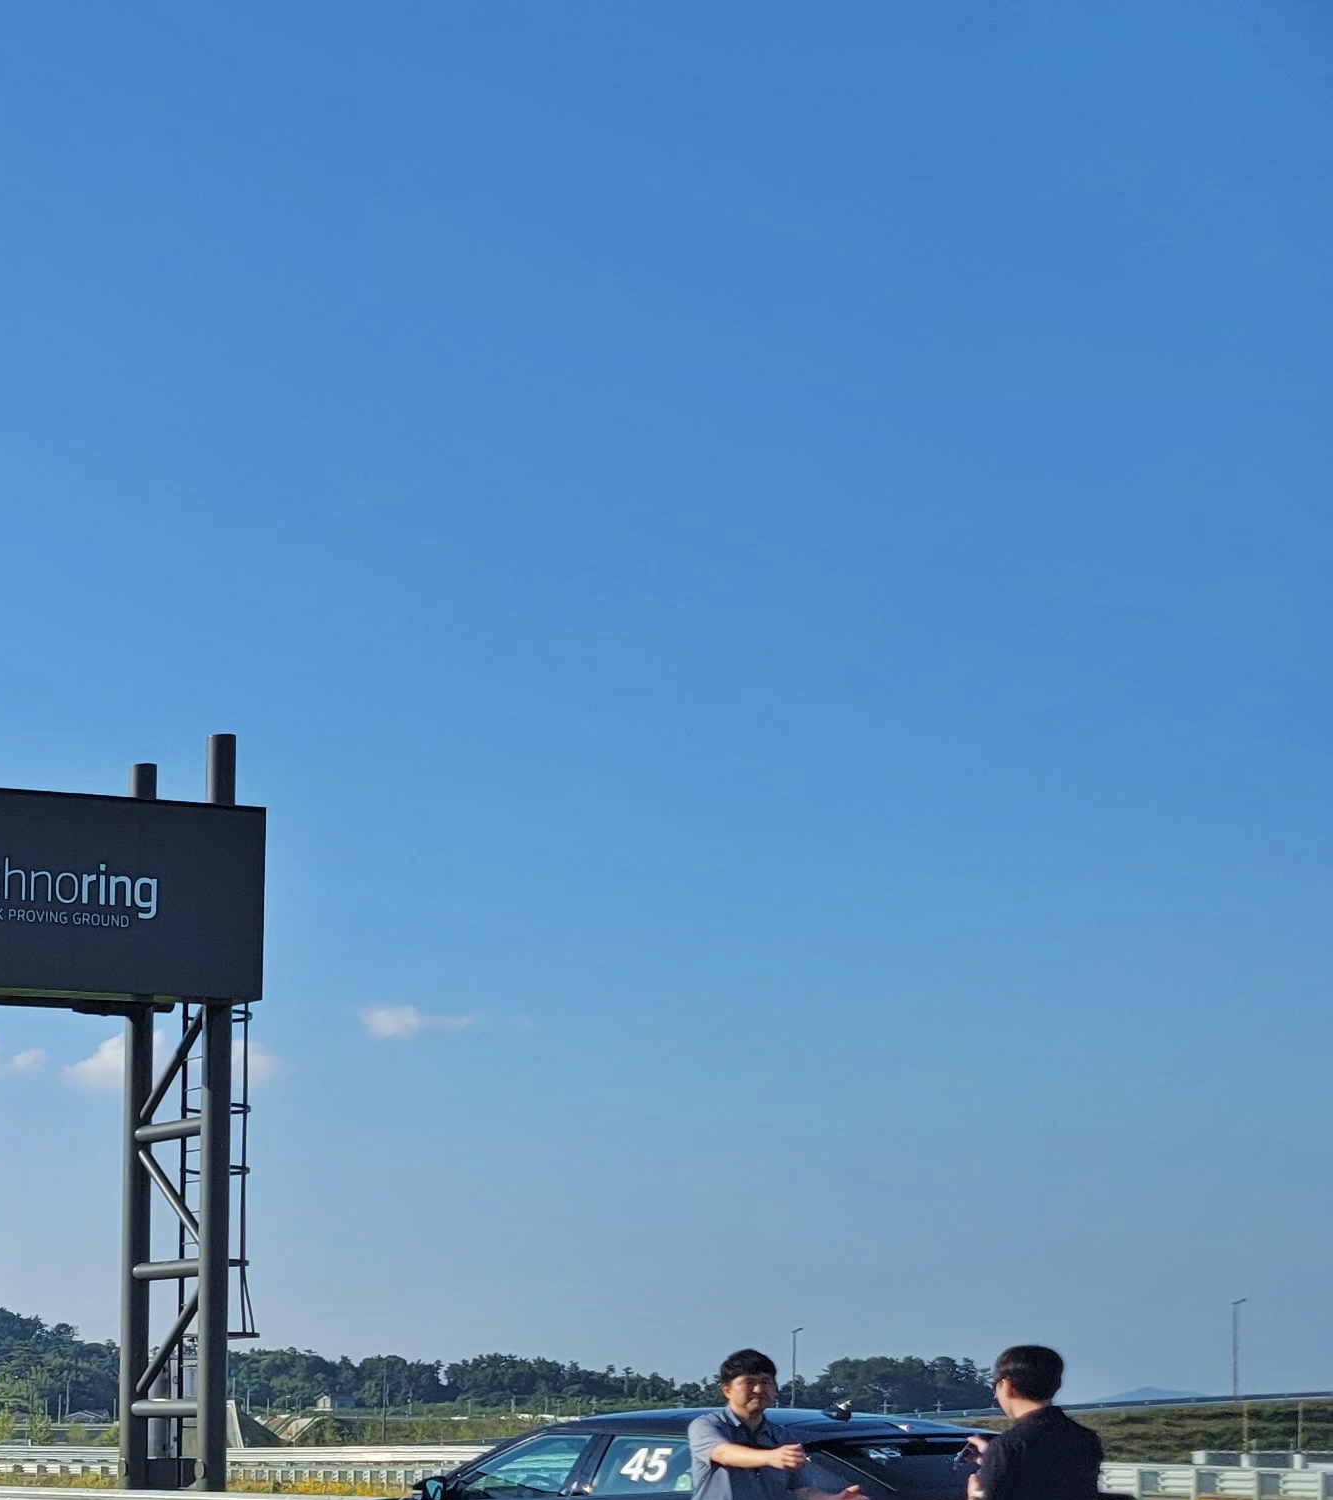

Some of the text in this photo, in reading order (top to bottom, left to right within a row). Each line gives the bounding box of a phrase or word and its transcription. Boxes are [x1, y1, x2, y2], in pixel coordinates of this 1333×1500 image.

[8, 908, 68, 924] PROVING
[72, 911, 130, 928] GROUND
[619, 1447, 673, 1483] 45
